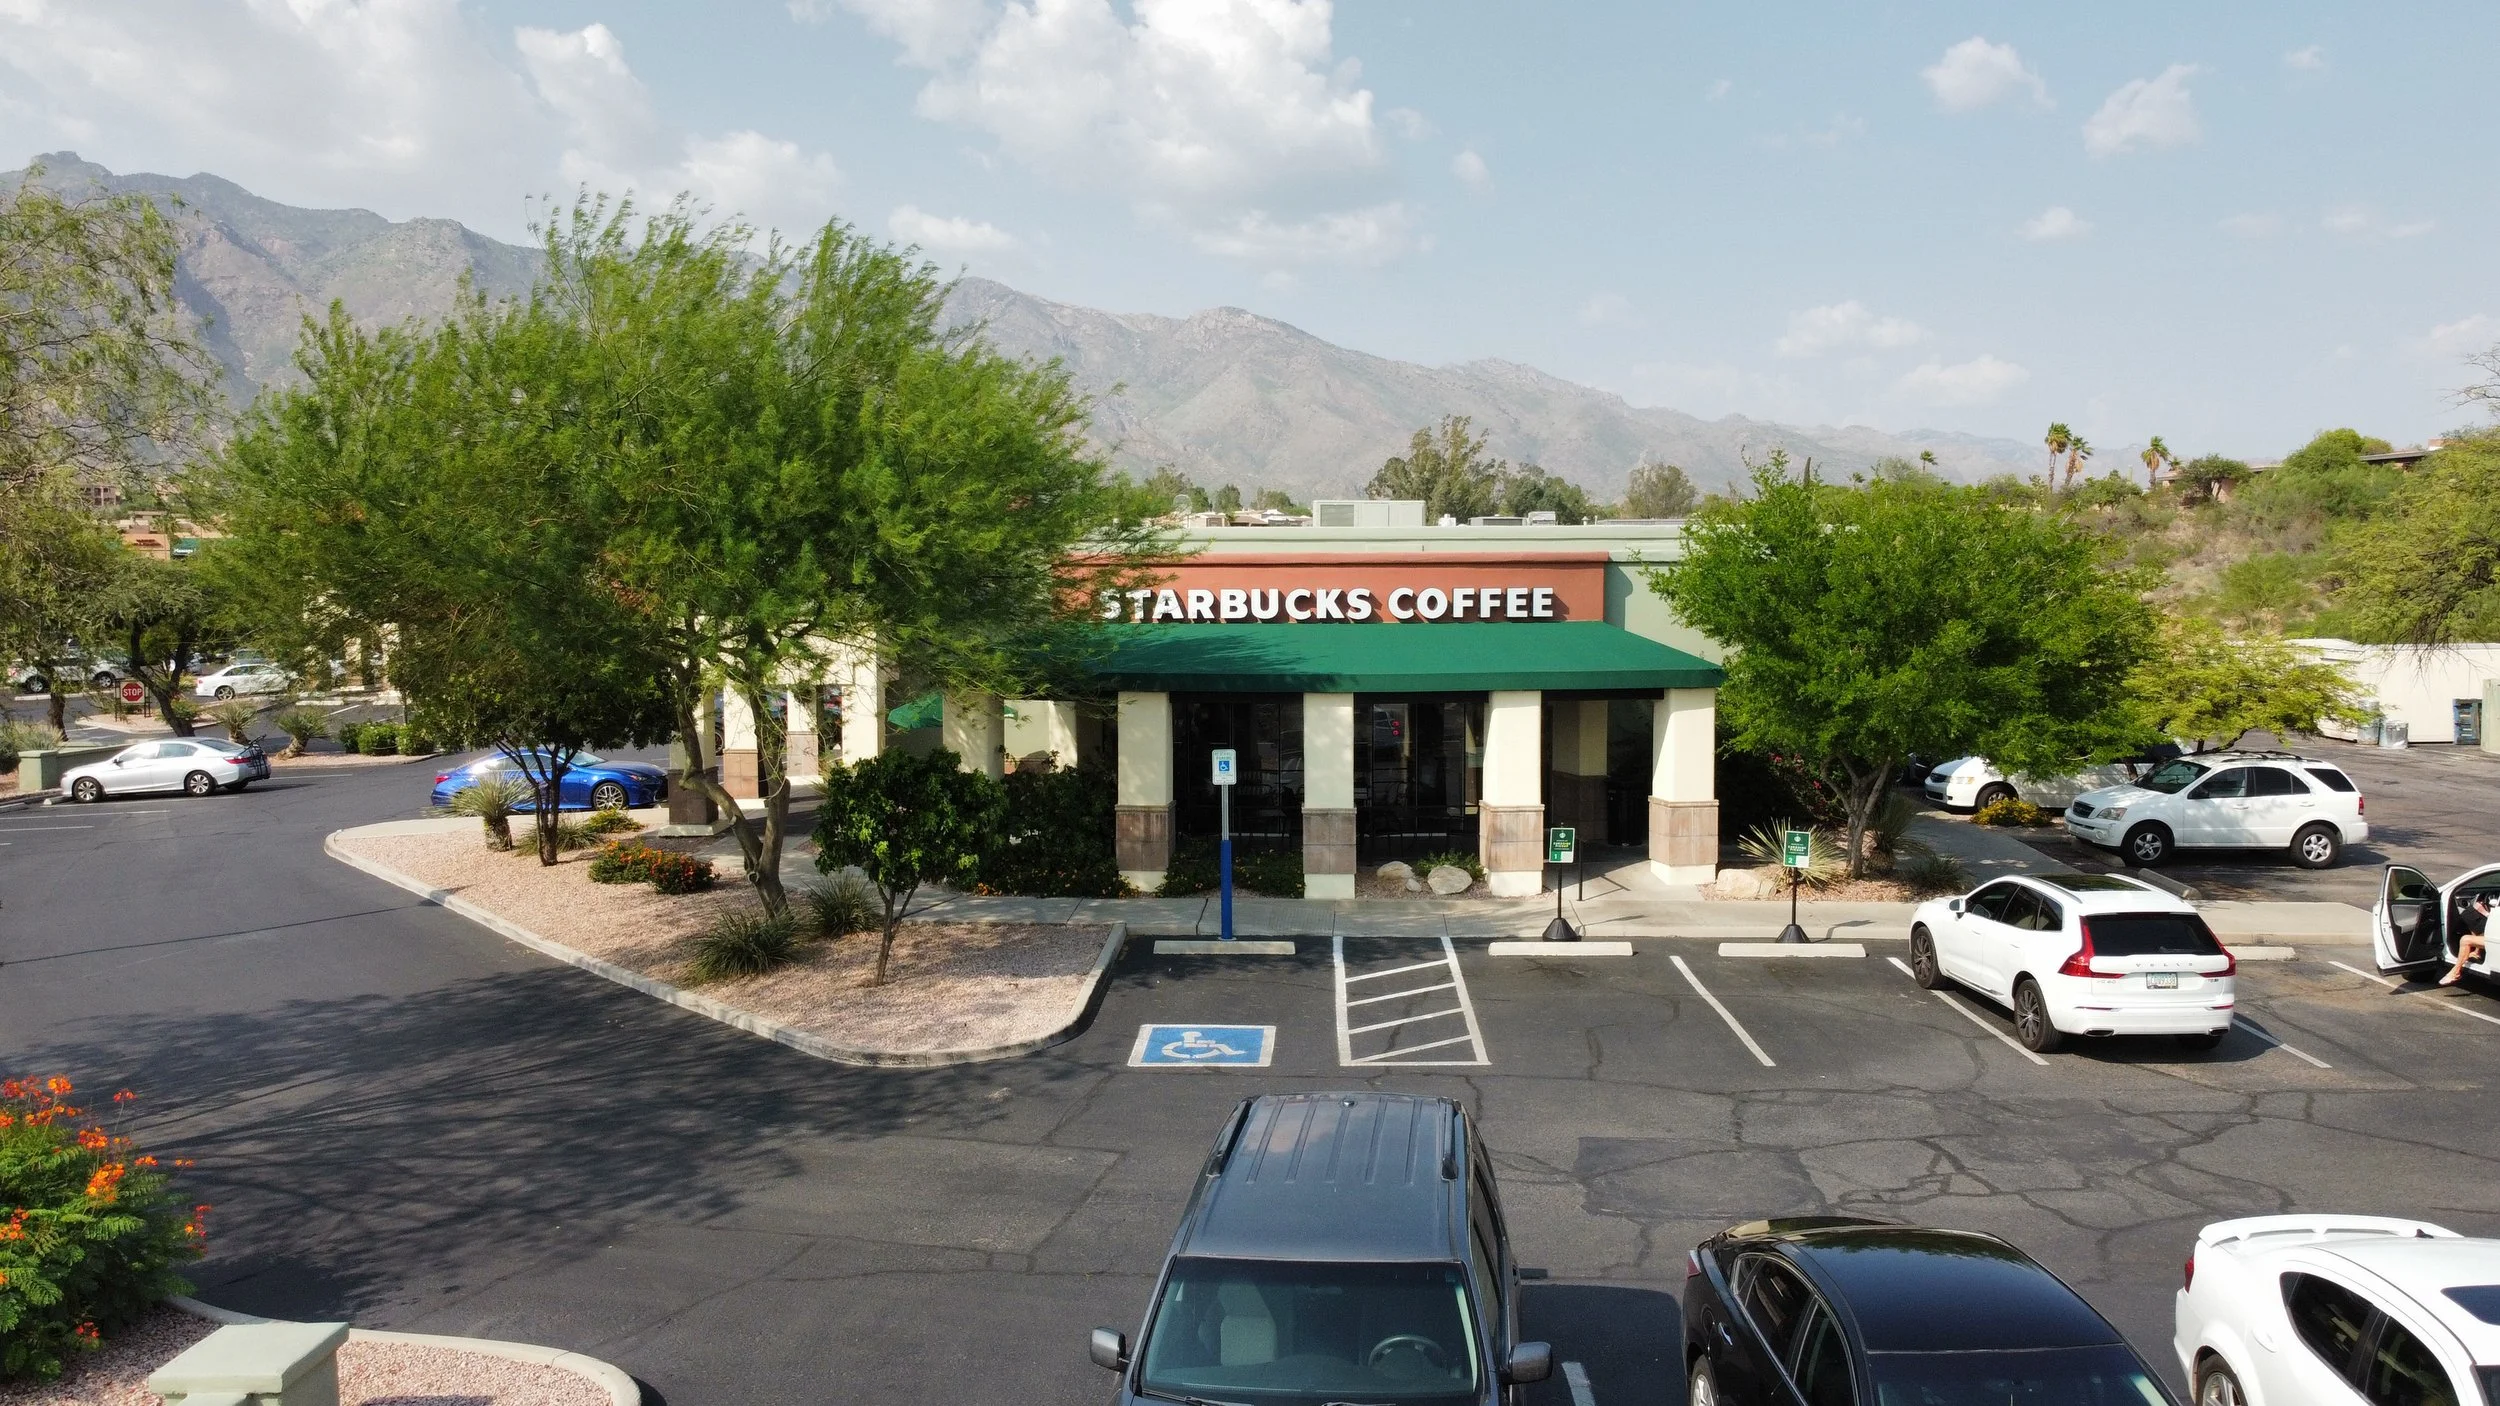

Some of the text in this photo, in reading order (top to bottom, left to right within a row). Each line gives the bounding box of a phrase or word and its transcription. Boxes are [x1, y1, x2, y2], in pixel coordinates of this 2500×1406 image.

[1099, 587, 1554, 620] STARBUCKS COFFEE
[123, 688, 142, 697] STOP
